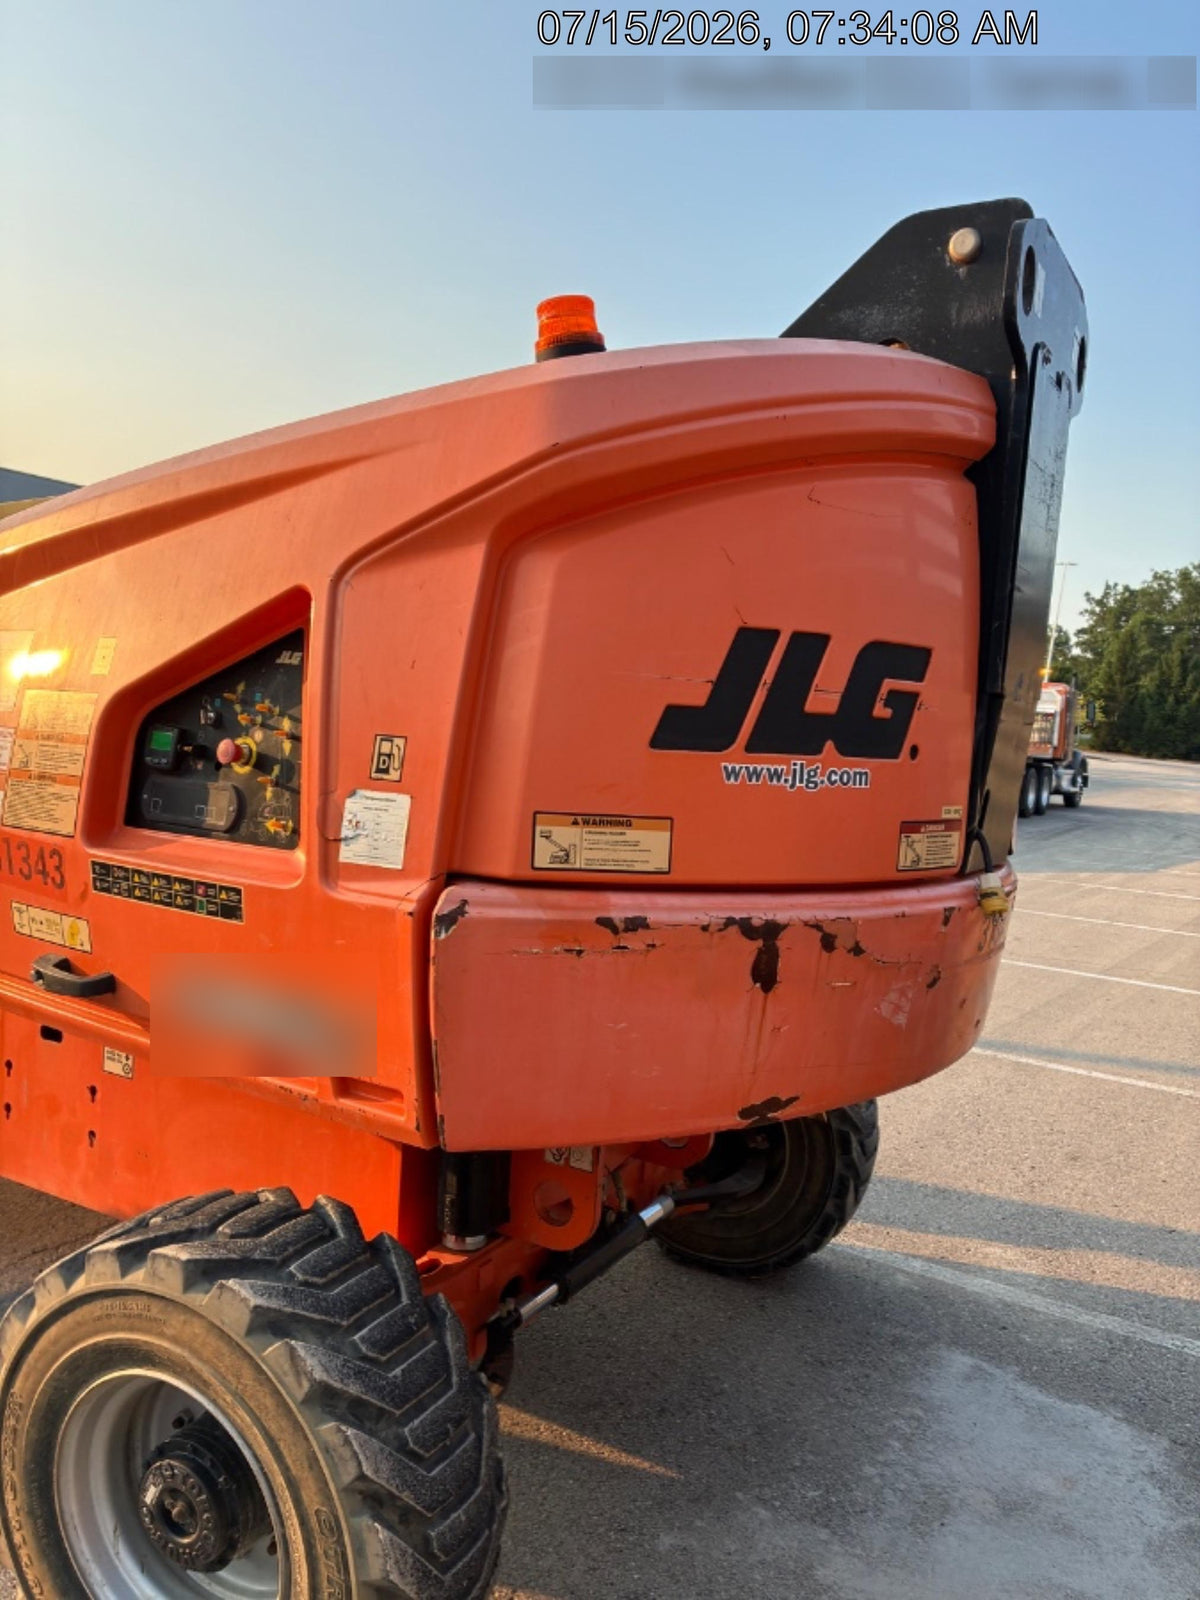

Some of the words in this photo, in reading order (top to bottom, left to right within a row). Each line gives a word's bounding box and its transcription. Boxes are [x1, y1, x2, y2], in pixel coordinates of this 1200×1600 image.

[275, 650, 303, 665] JLG
[721, 761, 870, 792] www.jlg.com
[580, 816, 633, 828] WARNING
[0, 836, 66, 890] 1343
